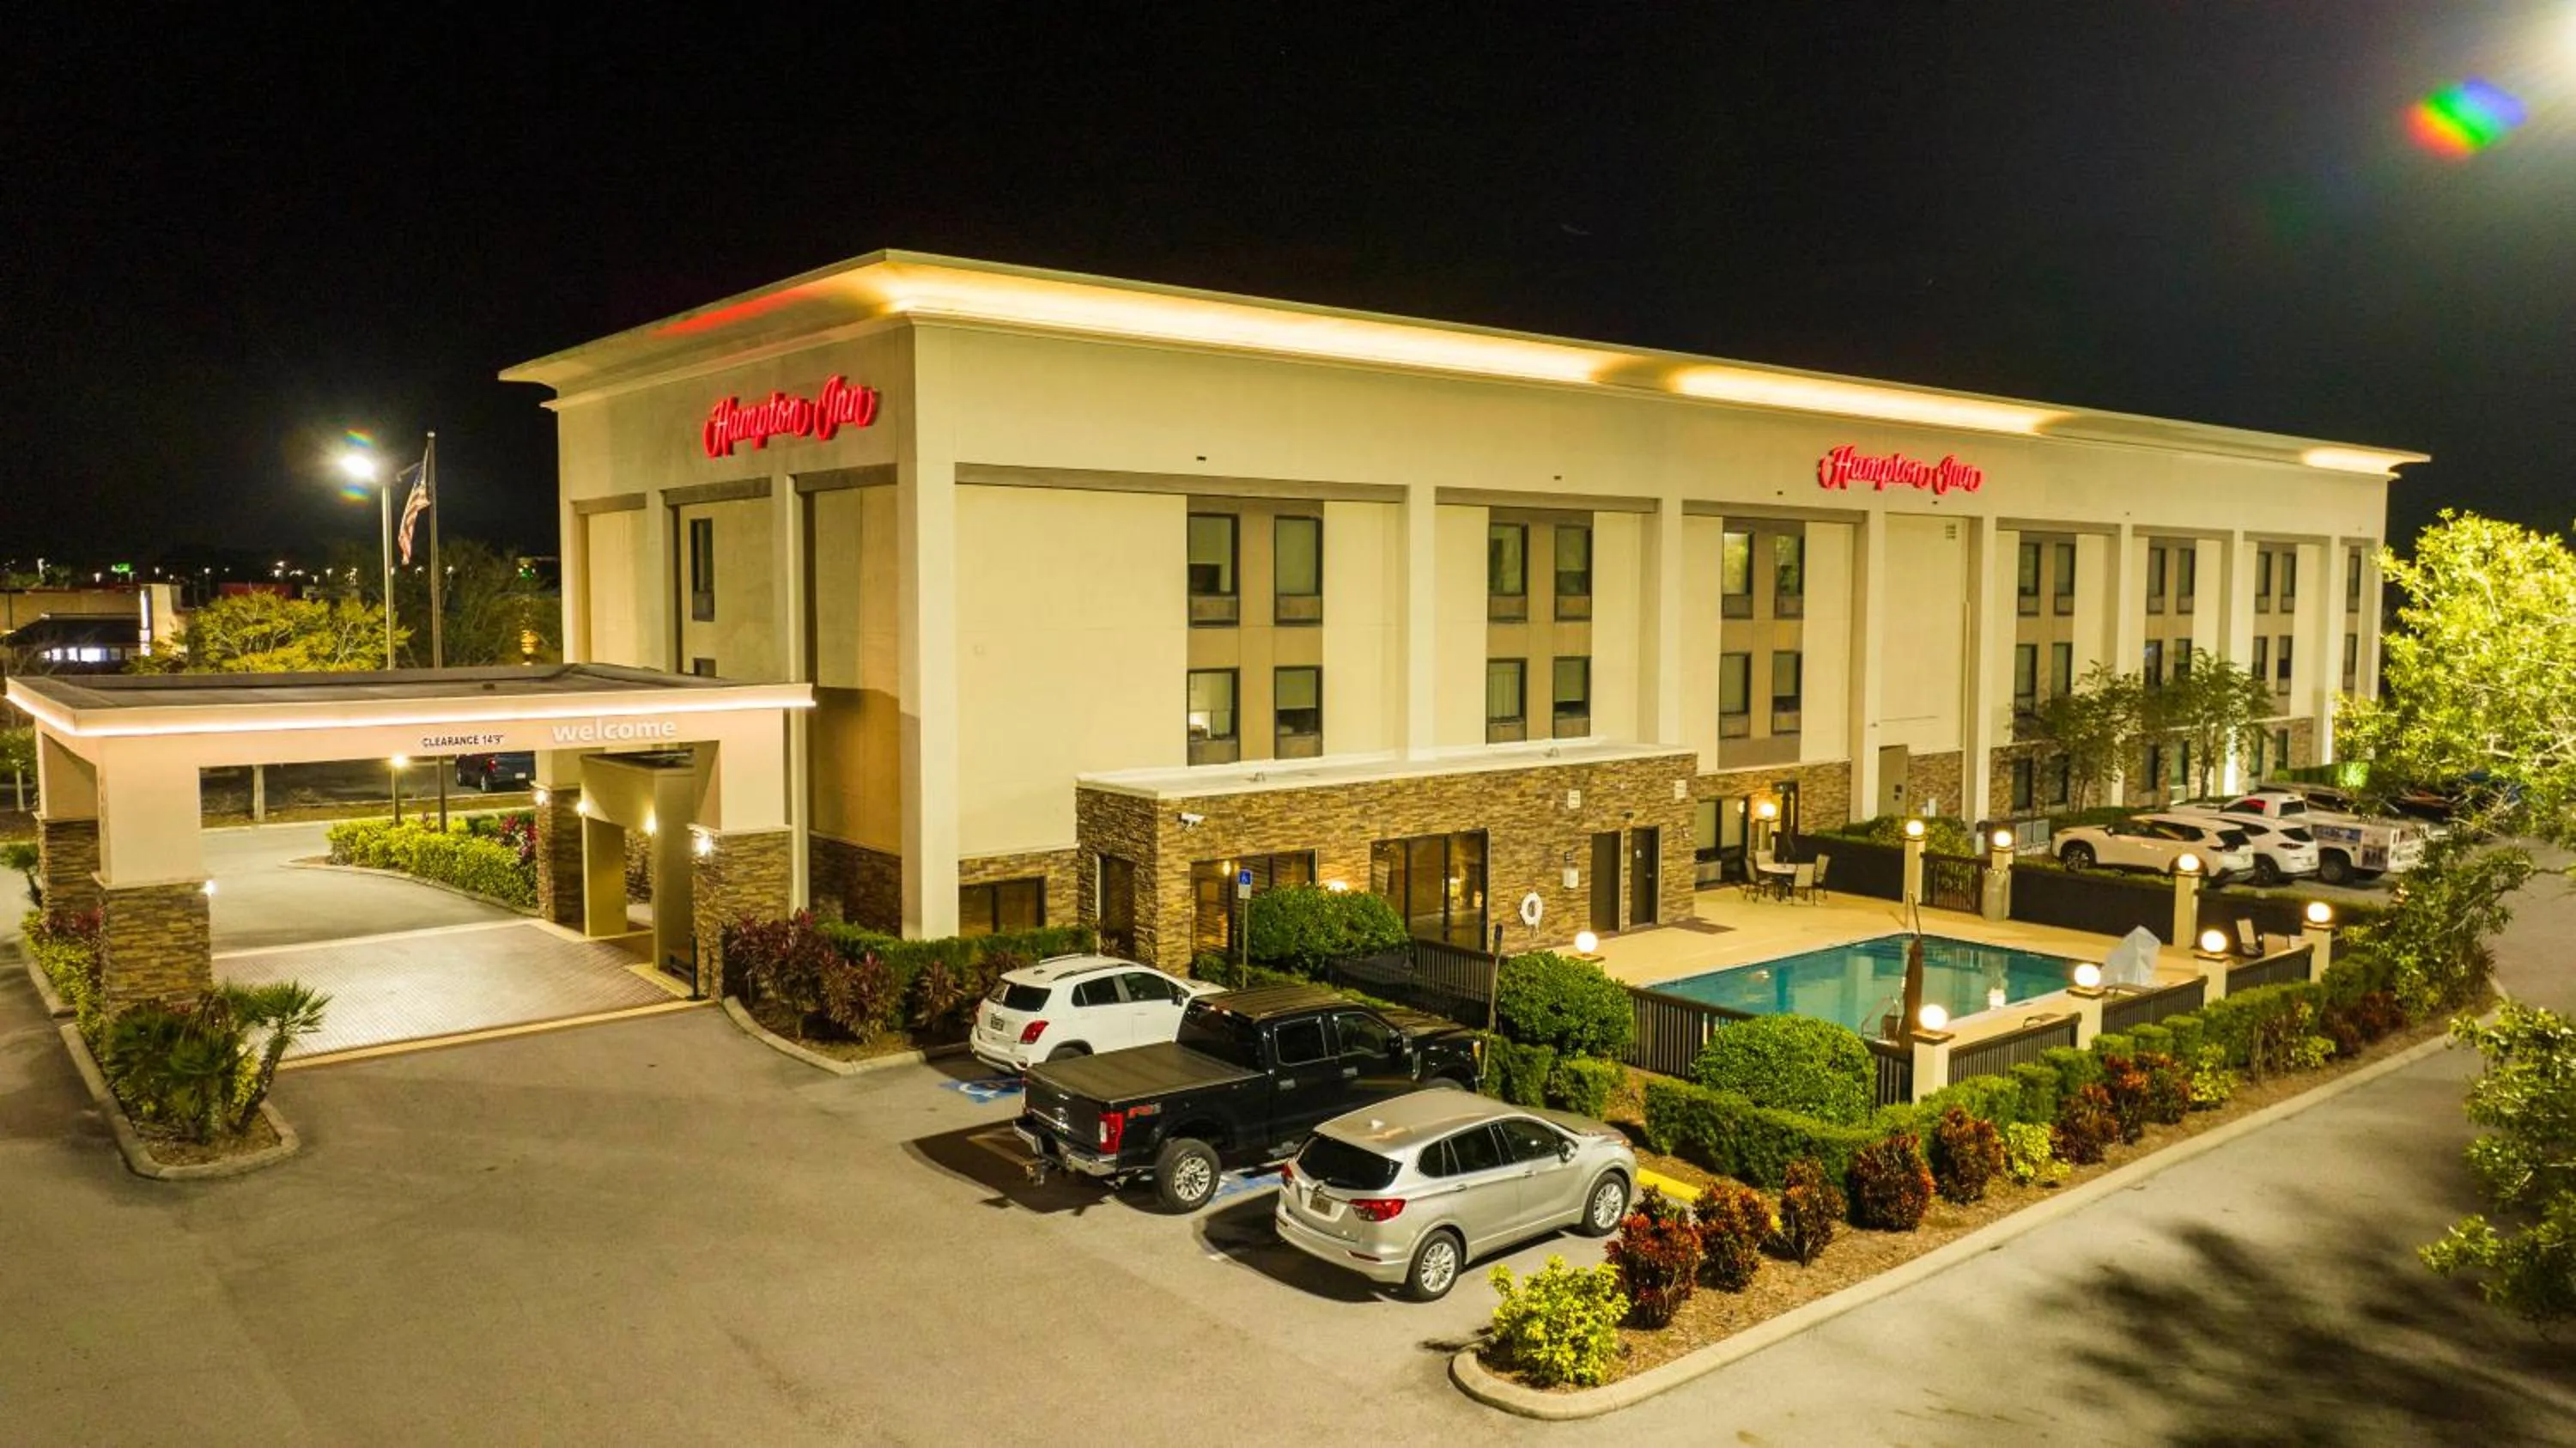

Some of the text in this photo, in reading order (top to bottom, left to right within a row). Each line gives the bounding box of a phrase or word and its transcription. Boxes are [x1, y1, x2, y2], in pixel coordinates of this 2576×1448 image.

[703, 374, 878, 458] Hampton Inn
[1817, 444, 1983, 496] Hampton Inn
[423, 735, 479, 748] CLEARANCE
[552, 719, 677, 742] welcome
